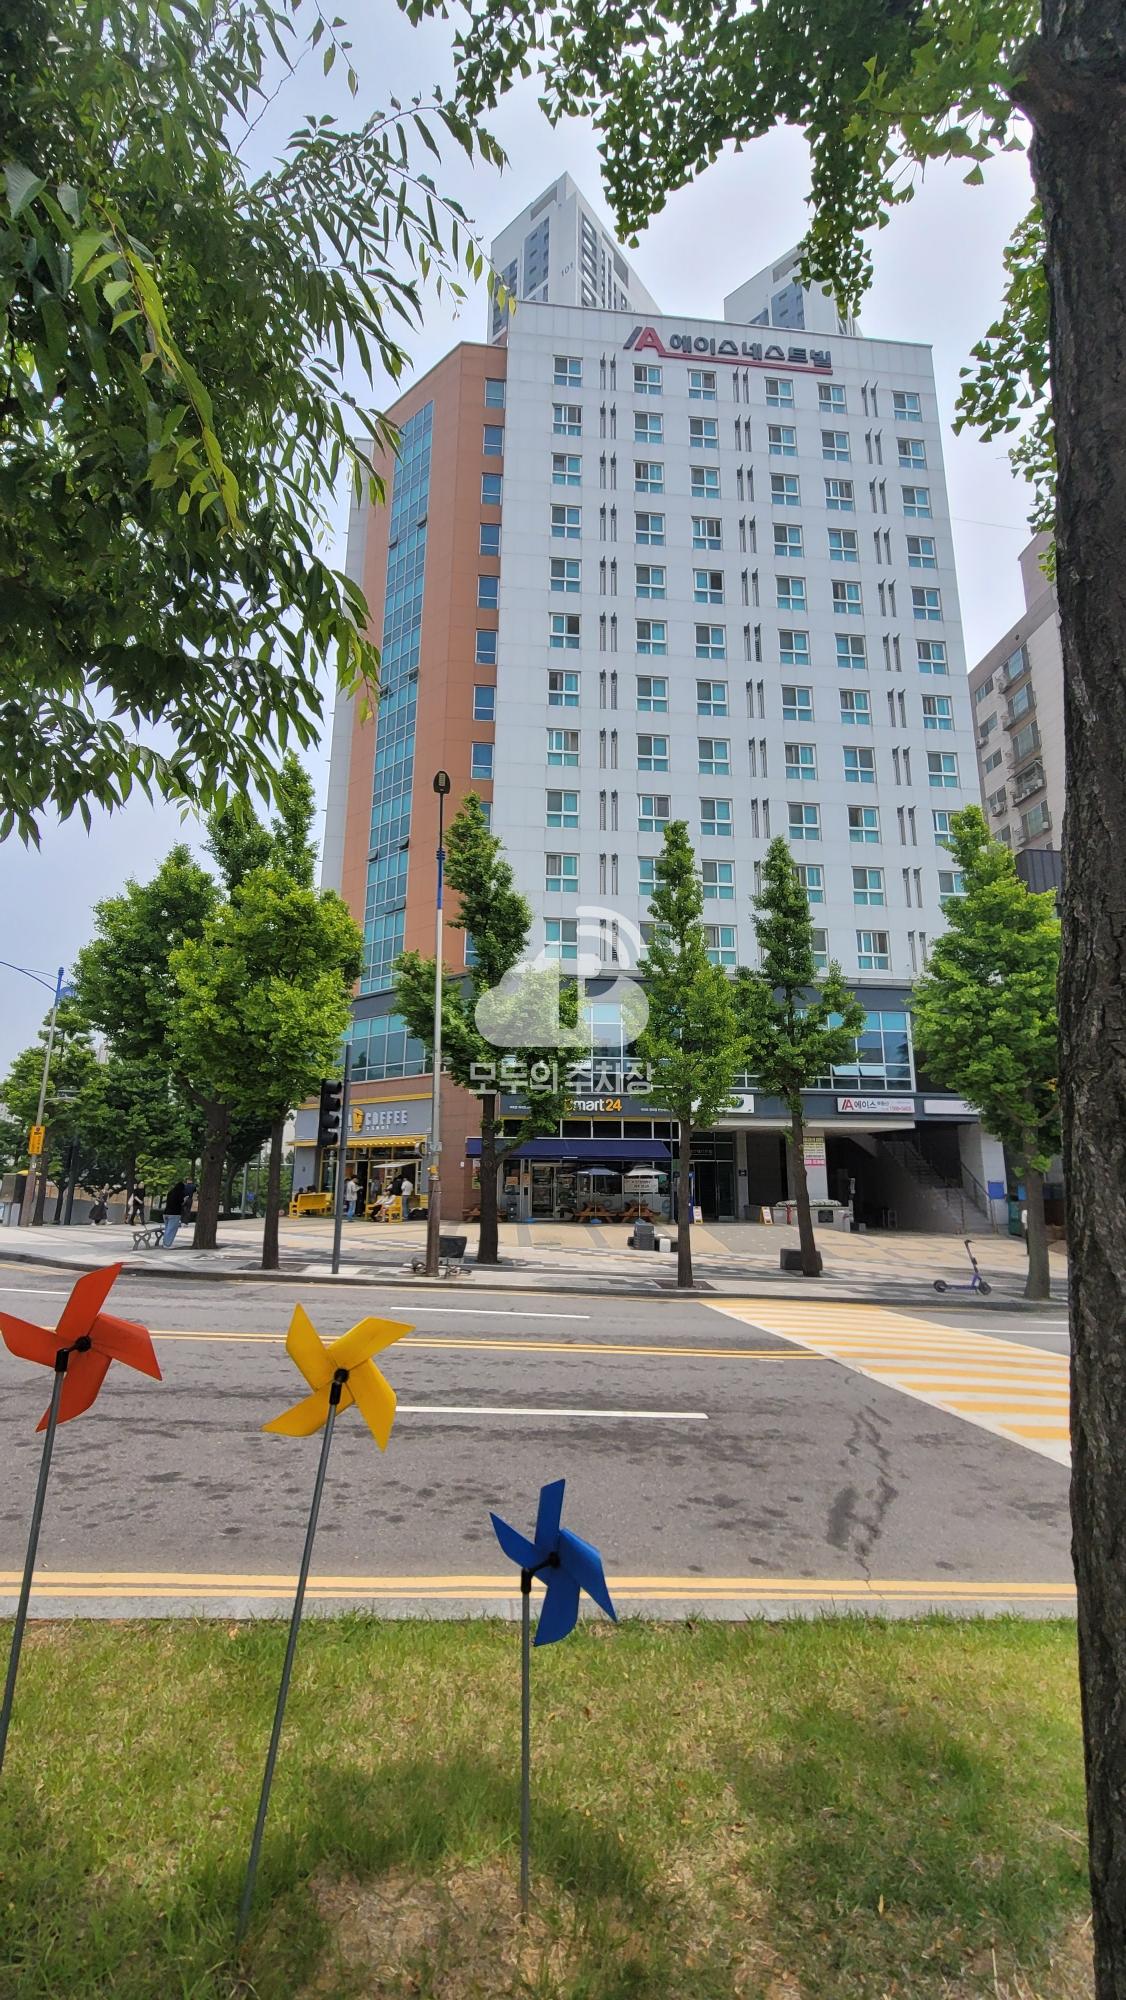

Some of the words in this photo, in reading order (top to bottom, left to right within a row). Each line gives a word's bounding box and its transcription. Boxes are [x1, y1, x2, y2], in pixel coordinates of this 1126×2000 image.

[669, 333, 832, 368] 에이스네스트빌
[854, 1099, 877, 1109] 에이스
[365, 1110, 408, 1125] COFFEE
